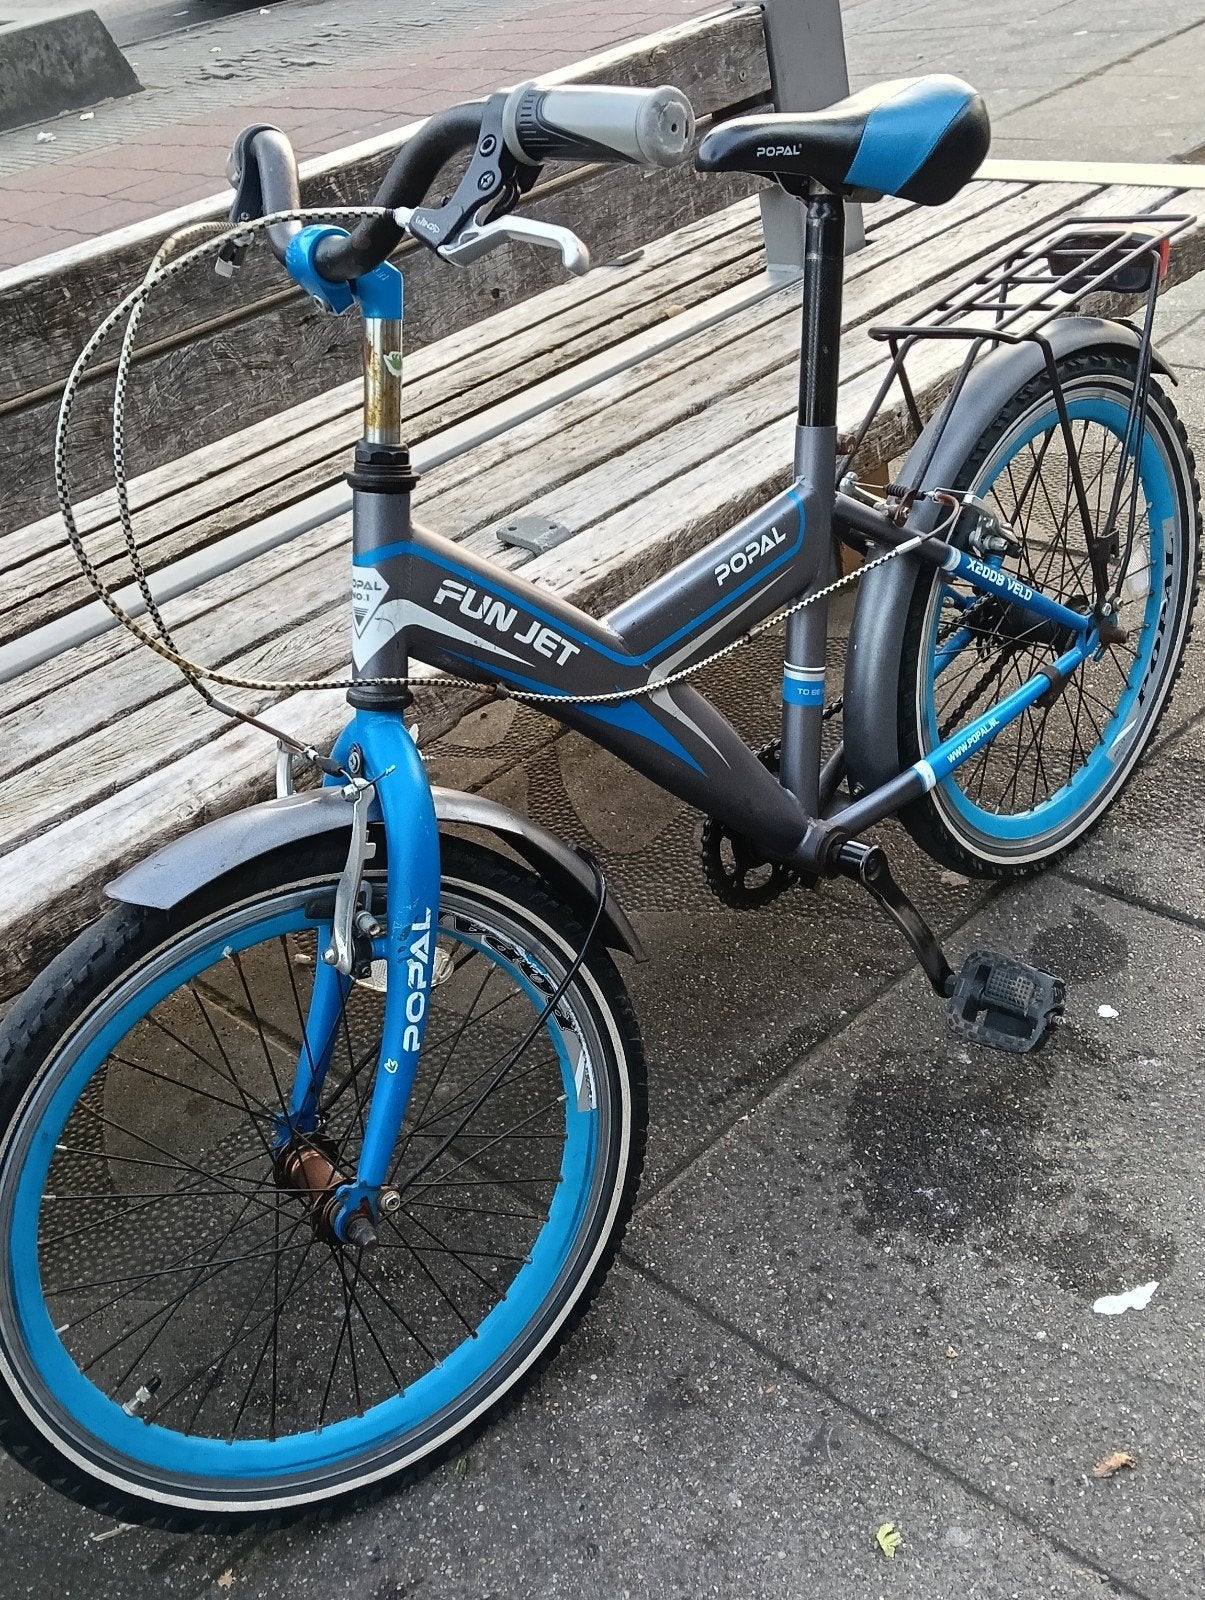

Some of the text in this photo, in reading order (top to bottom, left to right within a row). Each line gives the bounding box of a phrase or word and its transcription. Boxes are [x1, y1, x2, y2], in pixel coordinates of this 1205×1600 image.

[756, 144, 800, 157] POPAL
[714, 526, 787, 587] POPAL
[433, 579, 581, 667] FUN JET
[797, 687, 810, 696] TO
[402, 906, 432, 1052] POPAL
